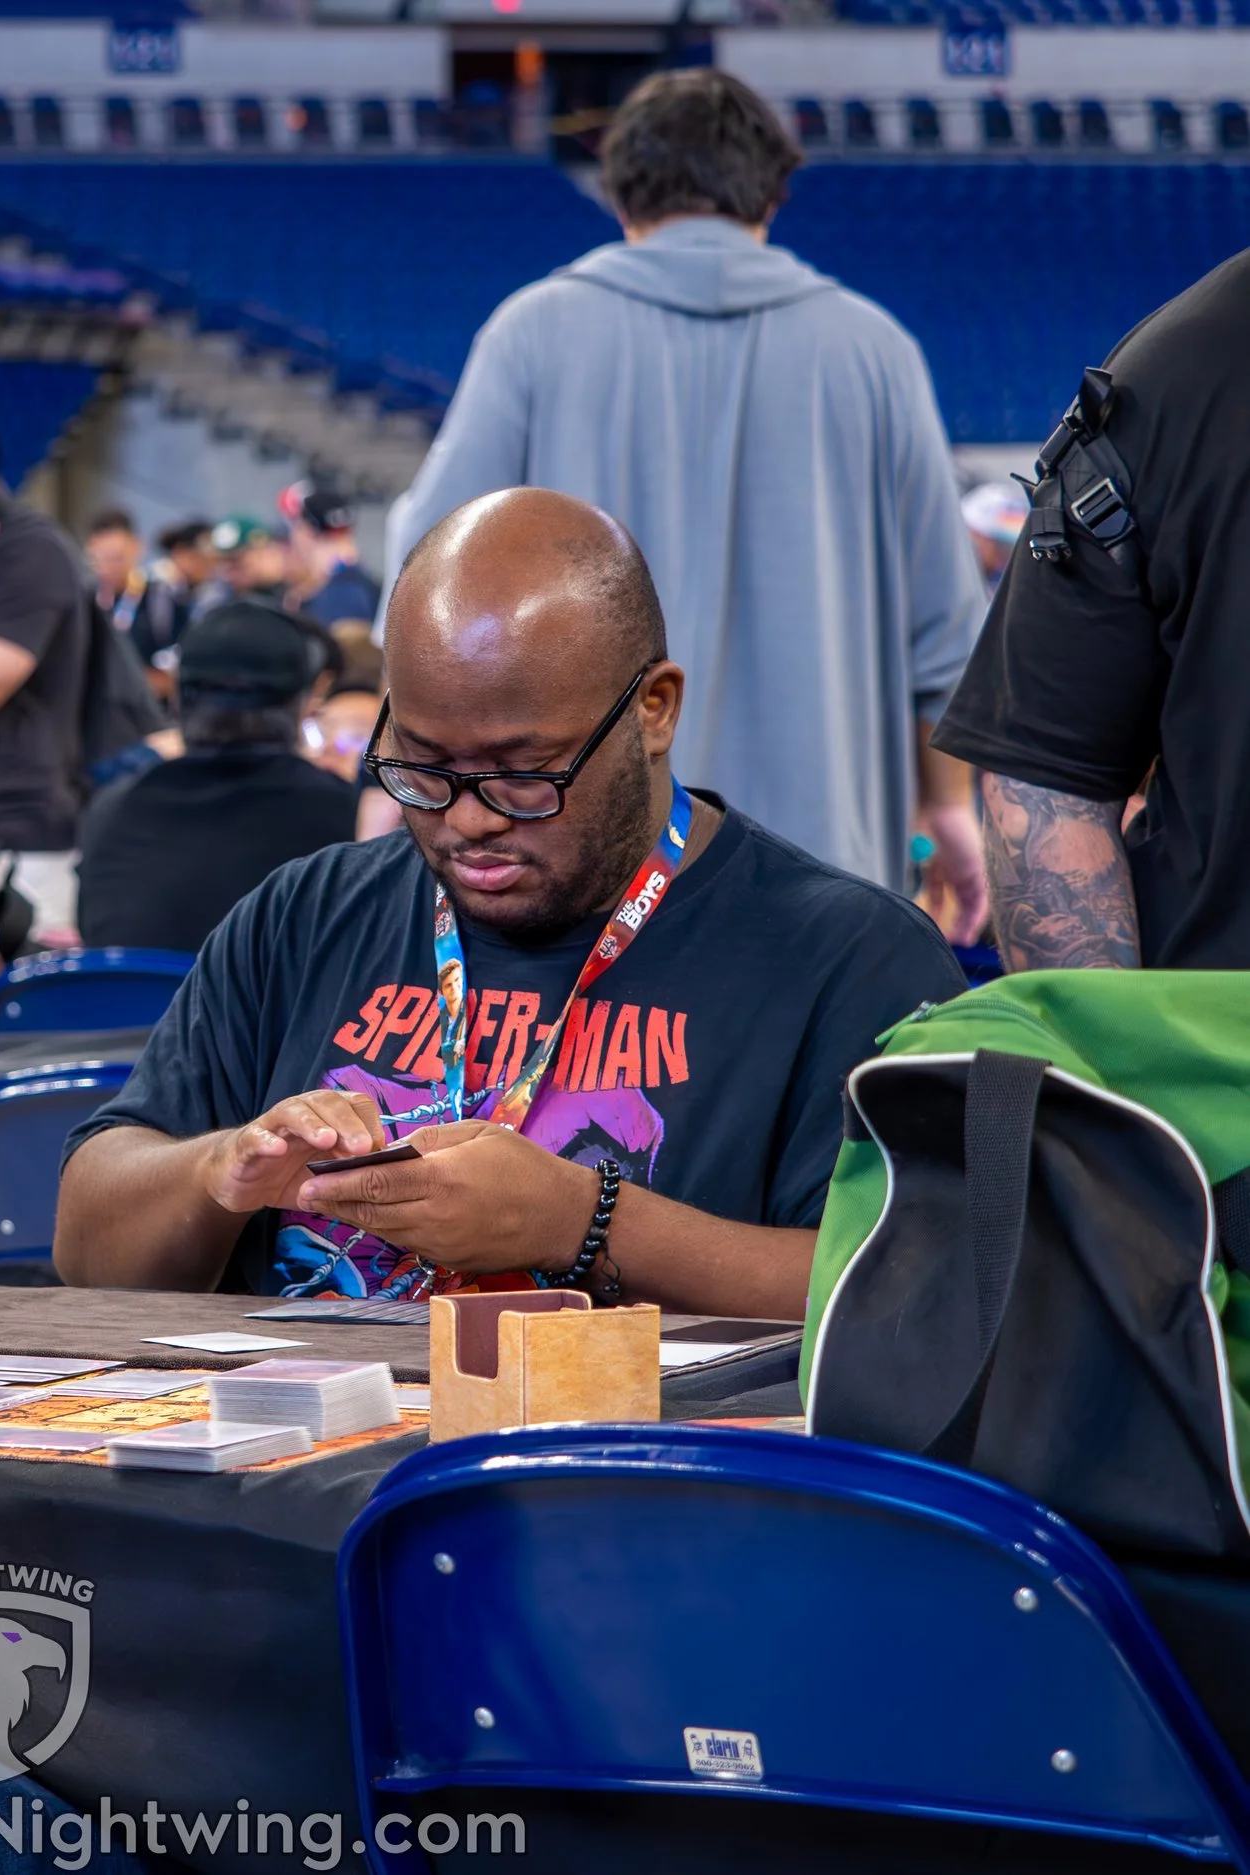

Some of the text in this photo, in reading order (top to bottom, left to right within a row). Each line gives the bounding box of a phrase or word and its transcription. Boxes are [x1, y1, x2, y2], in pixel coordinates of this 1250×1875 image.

[616, 900, 634, 923] THE
[625, 871, 666, 931] BOYS
[333, 983, 689, 1093] SPIDER-MAN
[705, 1732, 740, 1758] clarin
